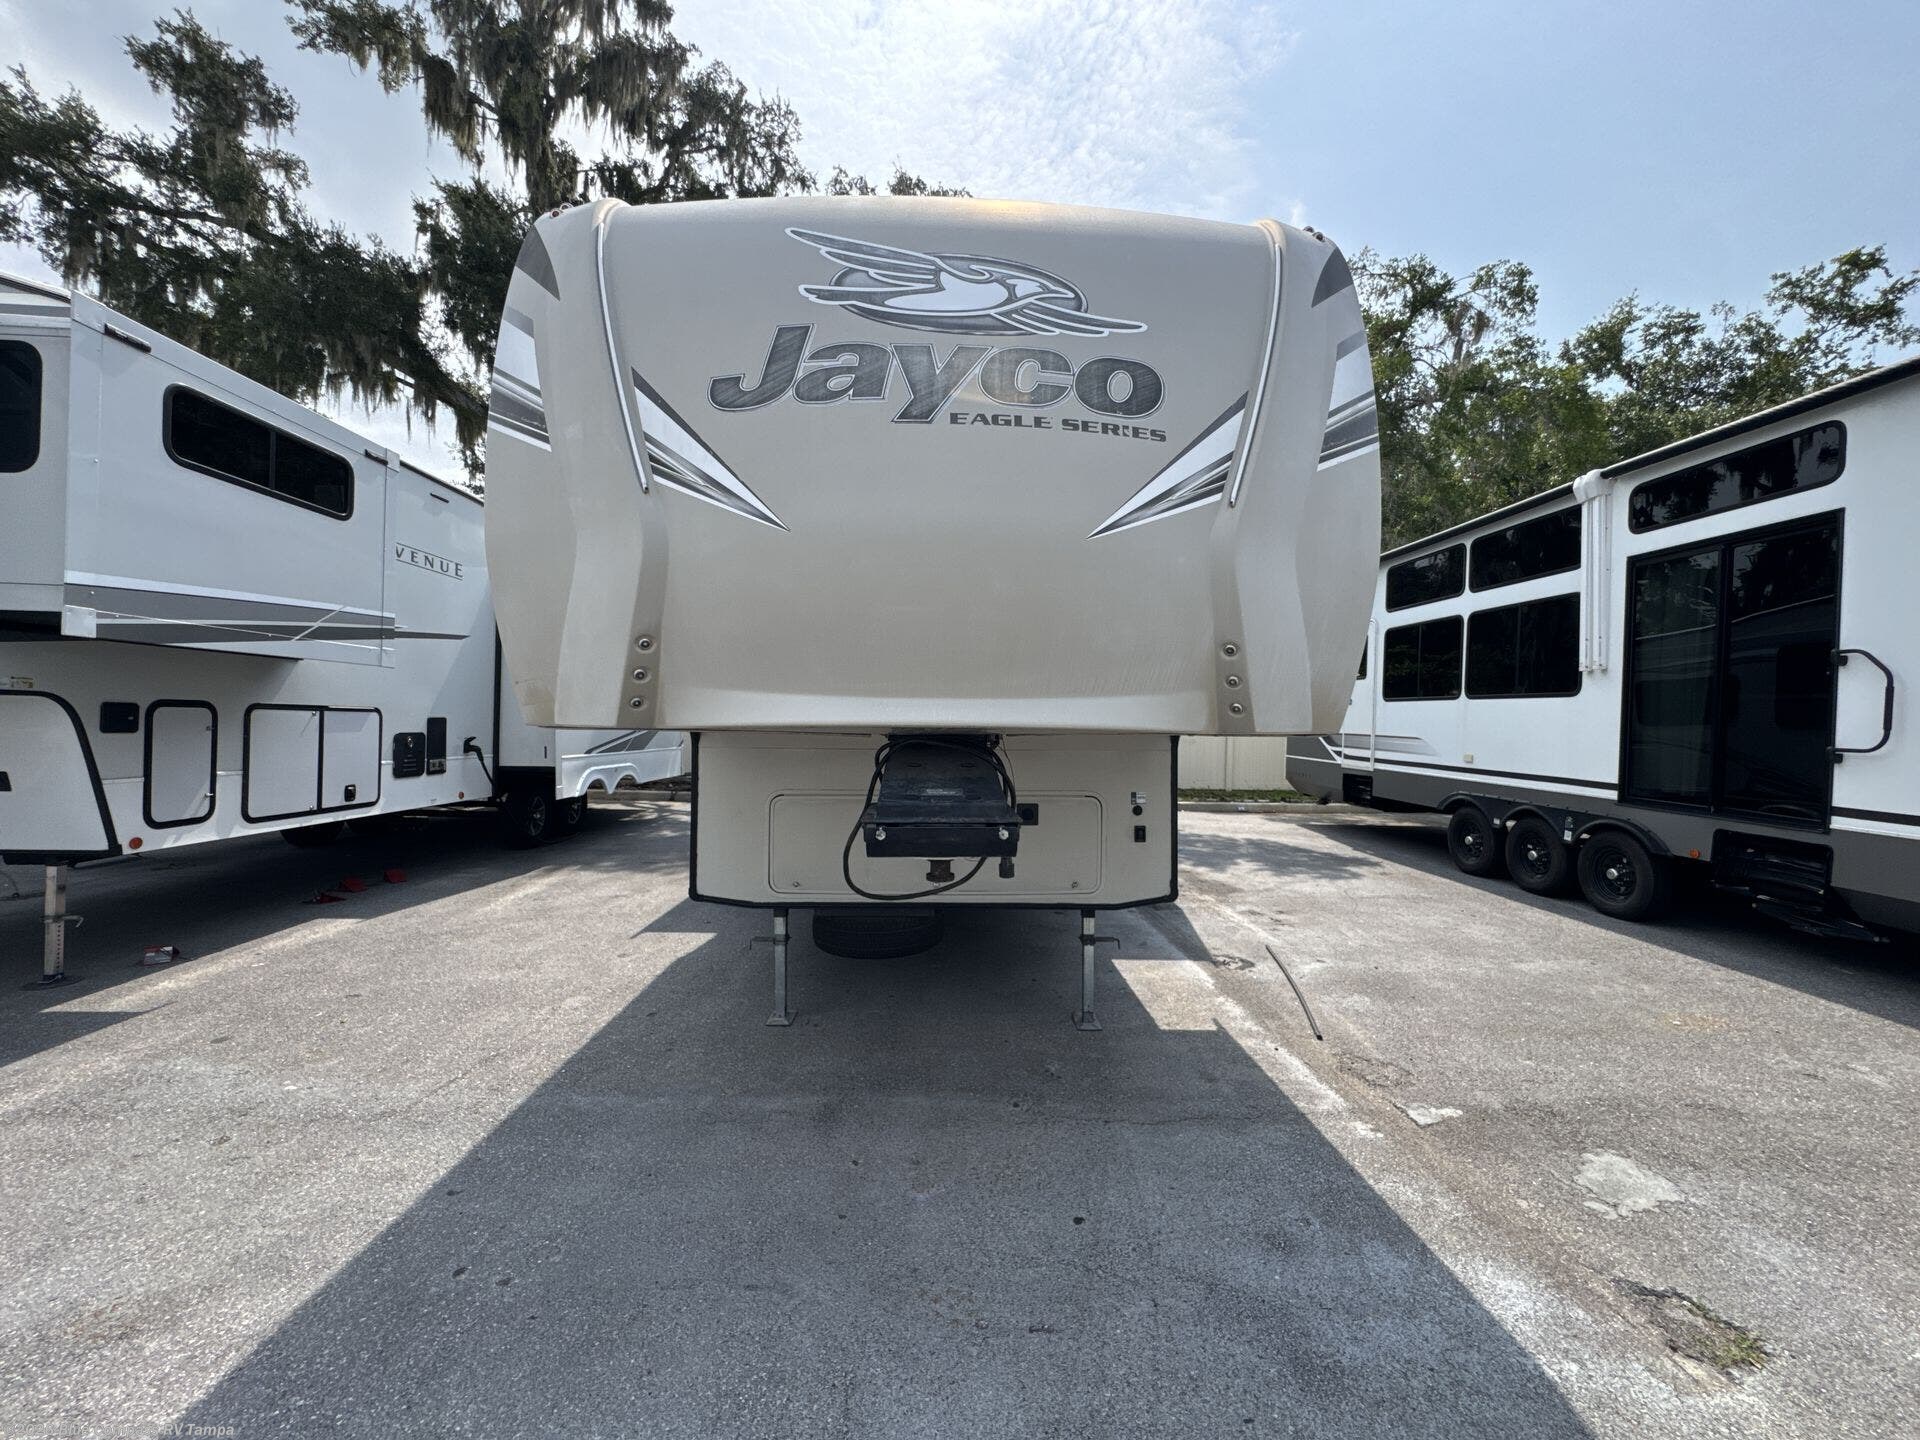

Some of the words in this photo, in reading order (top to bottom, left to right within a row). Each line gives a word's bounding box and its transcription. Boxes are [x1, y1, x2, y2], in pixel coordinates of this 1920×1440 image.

[707, 322, 1167, 424] Jayco
[949, 411, 1053, 430] EAGLE
[1061, 417, 1168, 443] SERIES
